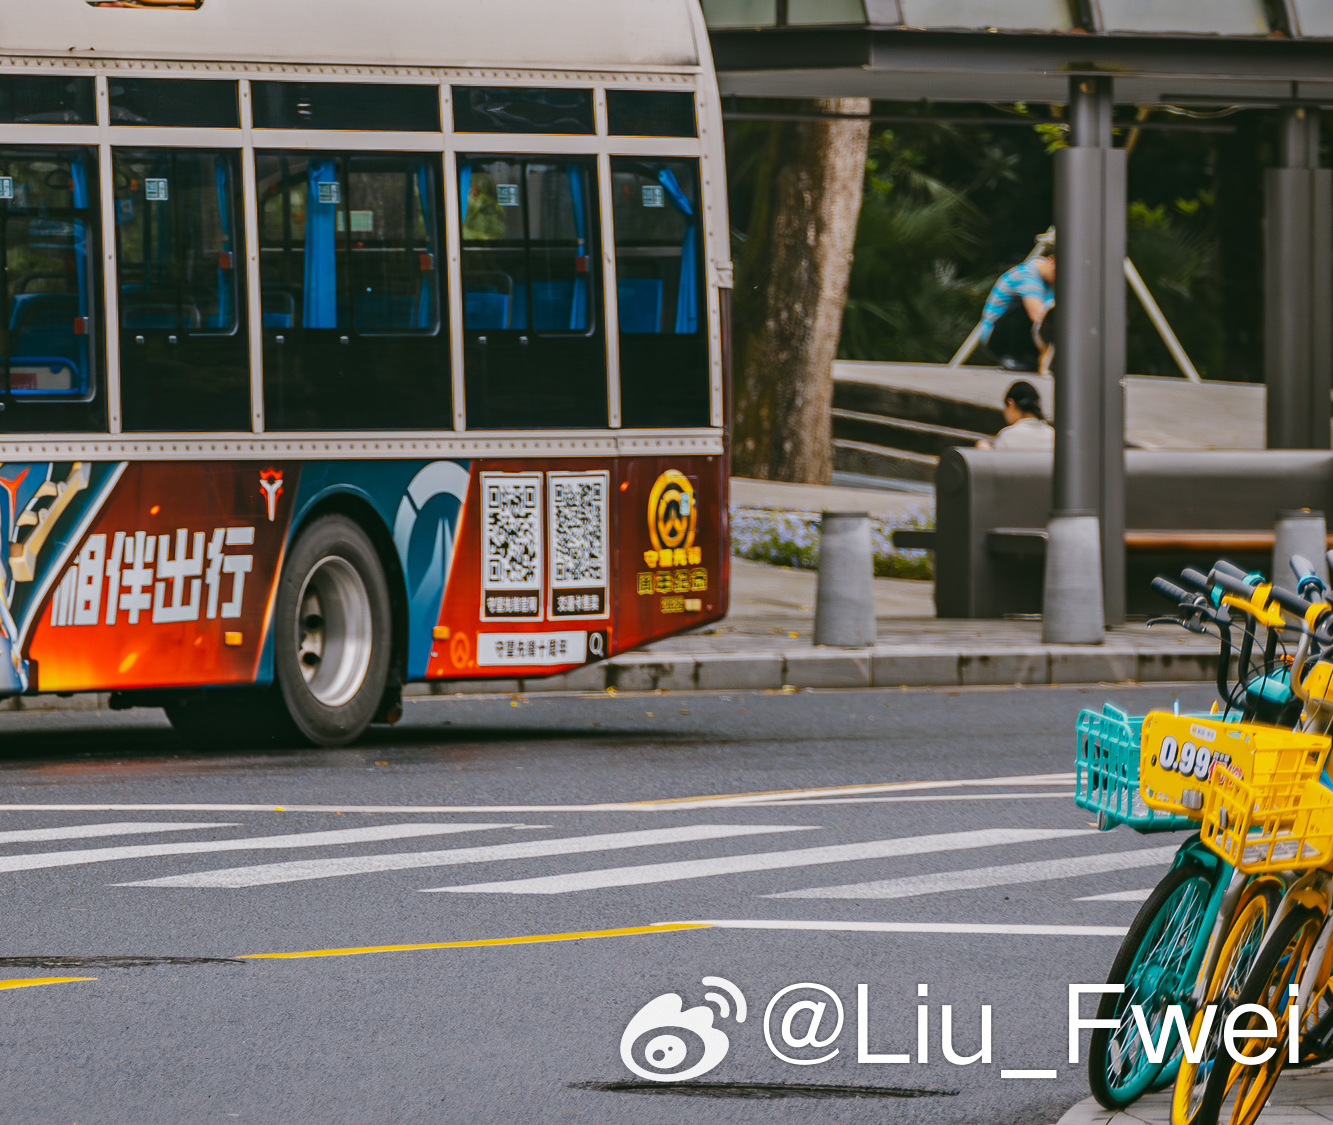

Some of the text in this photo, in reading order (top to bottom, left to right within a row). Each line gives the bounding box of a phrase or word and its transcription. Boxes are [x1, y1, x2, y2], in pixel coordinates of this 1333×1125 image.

[51, 526, 256, 627] 相伴出行
[1159, 735, 1212, 782] 0.99
